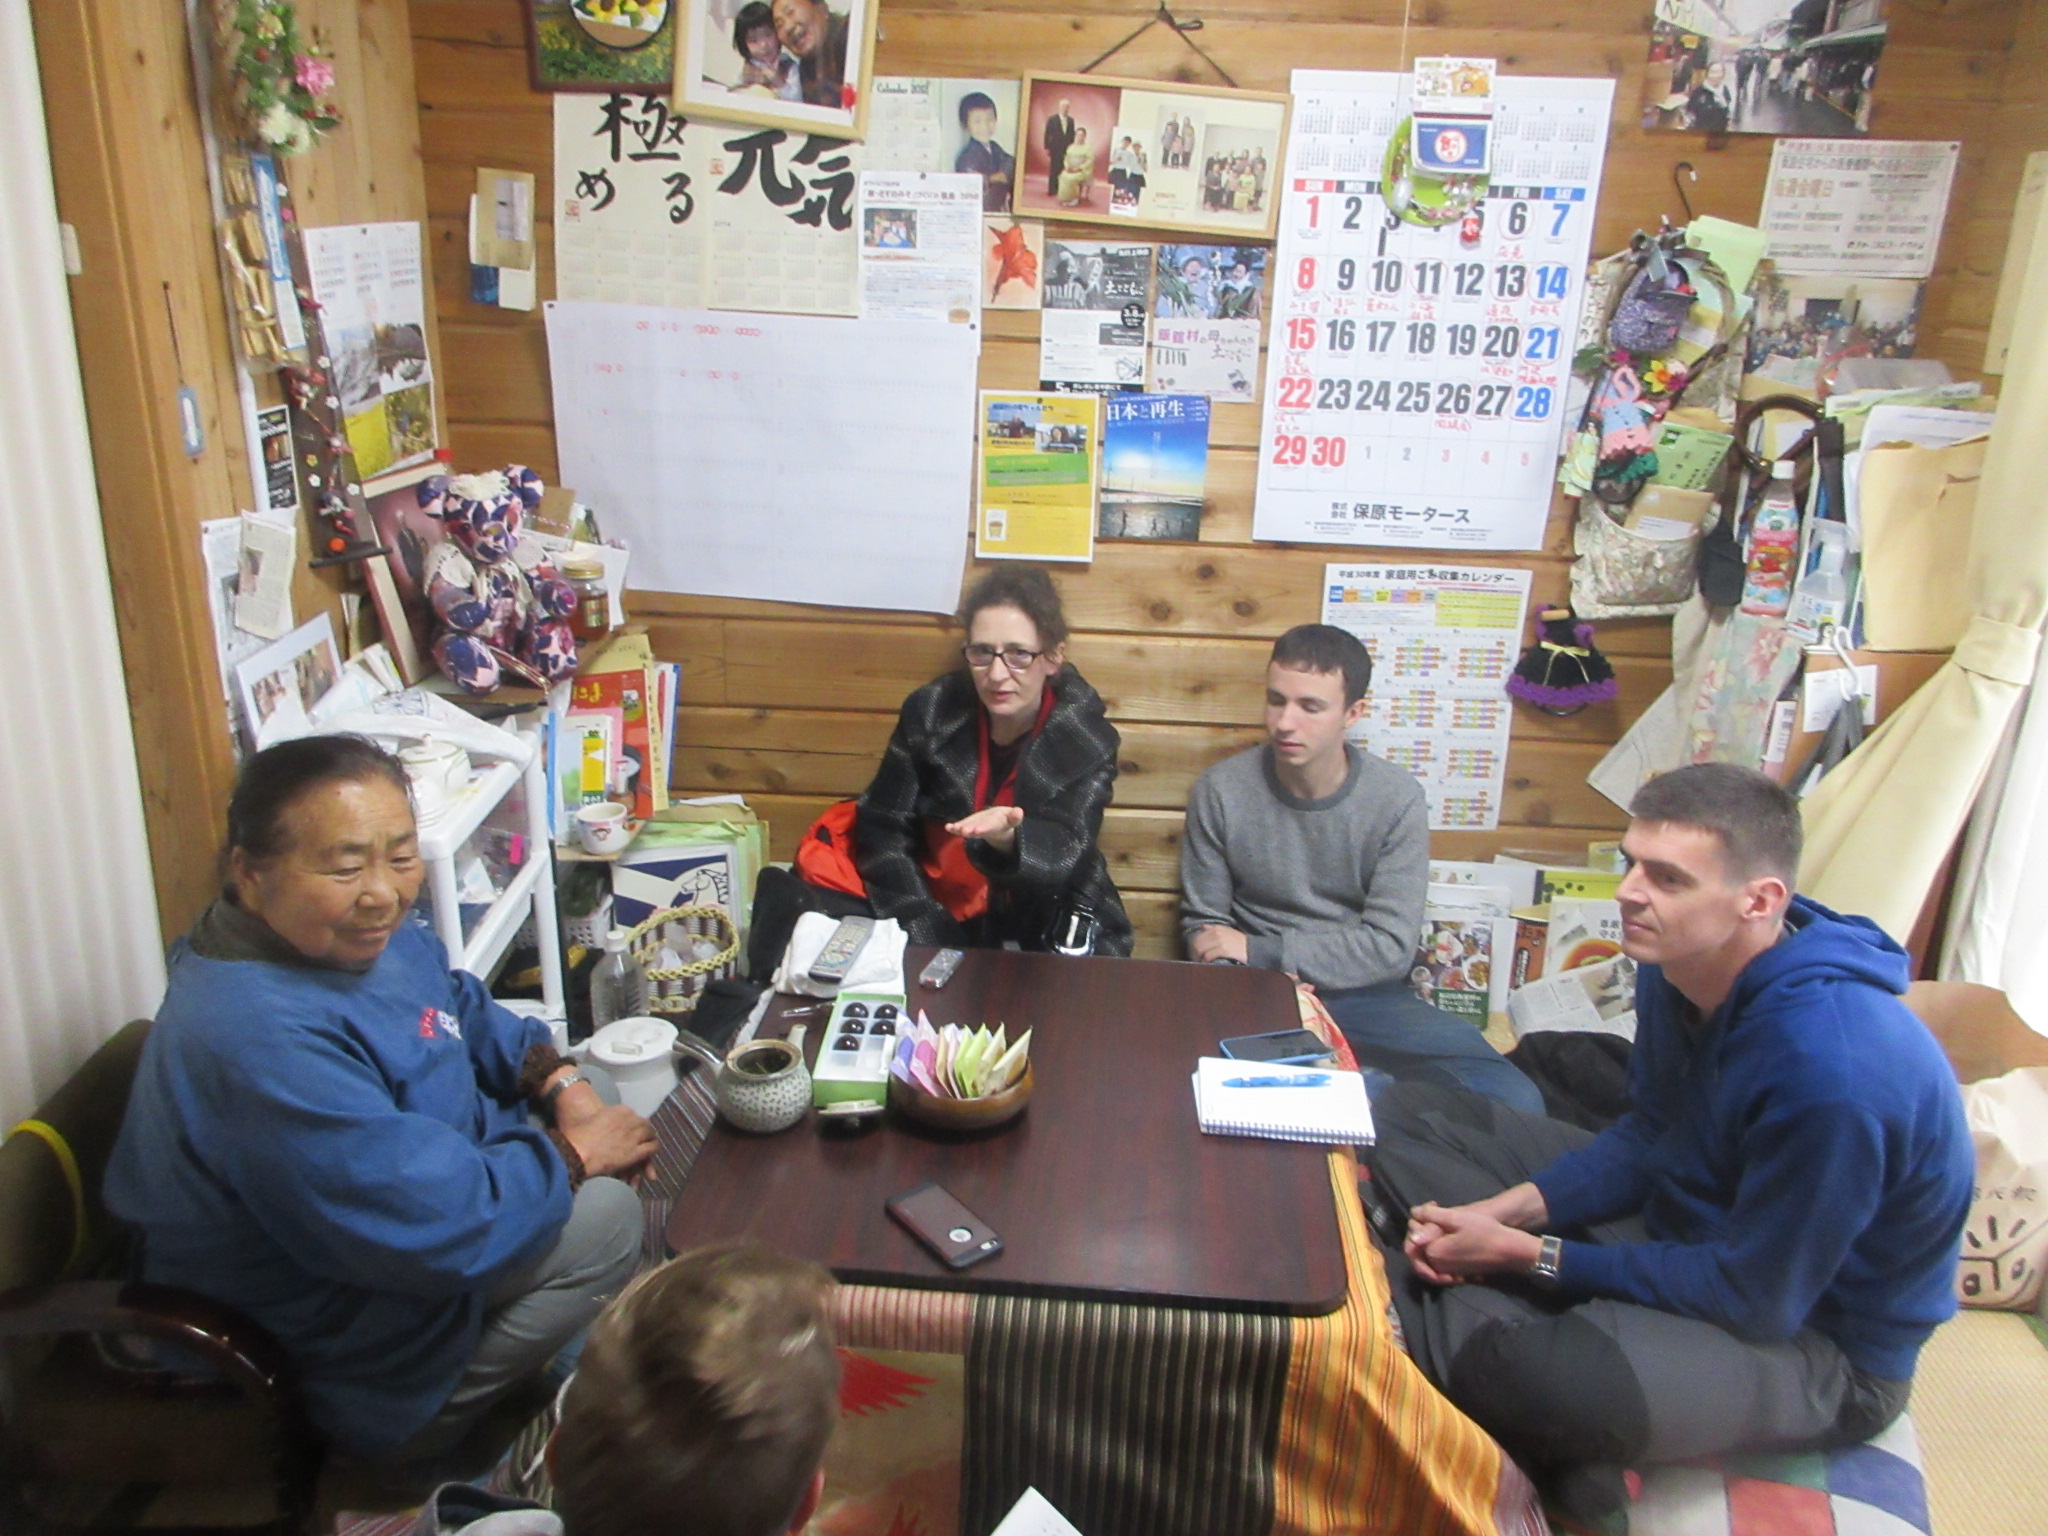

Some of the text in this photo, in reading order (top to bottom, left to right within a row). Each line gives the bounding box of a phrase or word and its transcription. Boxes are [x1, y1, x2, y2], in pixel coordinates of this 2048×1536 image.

[594, 93, 687, 163] 極
[718, 131, 854, 231] 元気
[1307, 196, 1319, 228] 1
[1344, 197, 1361, 229] 2
[1509, 202, 1527, 234] 6
[1552, 204, 1570, 236] 7
[1299, 258, 1568, 299] 8 9 10 11 12 13 14
[1287, 318, 1559, 359] 15 16 17 18 19 20 21
[1106, 399, 1186, 422] 日本と再生
[1278, 377, 1551, 418] 22 23 24 25 26 27 28
[1272, 435, 1307, 465] 29
[1313, 437, 1345, 466] 30
[1365, 445, 1371, 459] 1
[1402, 447, 1411, 461] 2
[1441, 449, 1450, 463] 3
[1481, 451, 1490, 465] 4
[1353, 503, 1471, 523] 保原モータース
